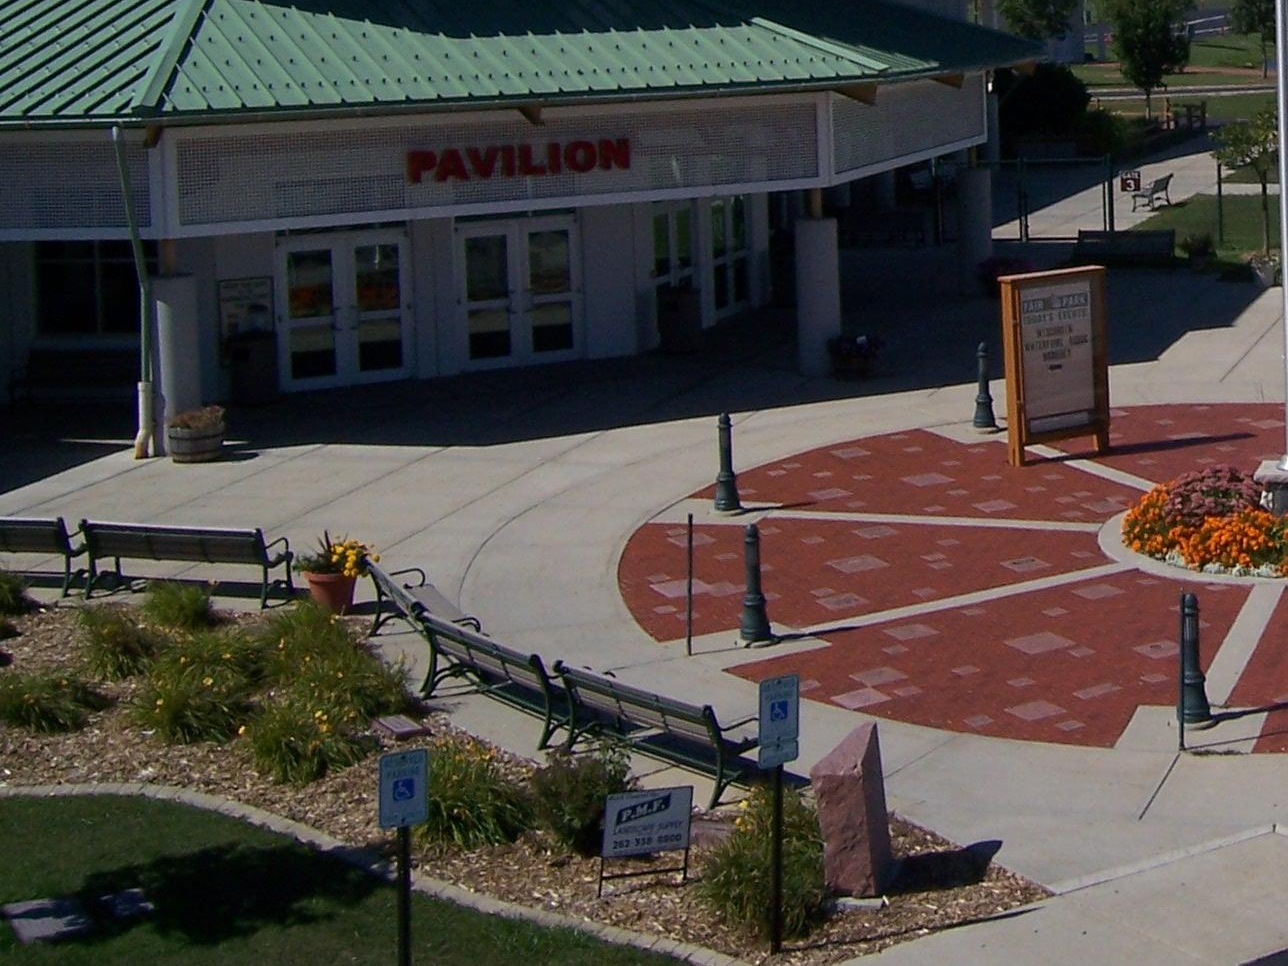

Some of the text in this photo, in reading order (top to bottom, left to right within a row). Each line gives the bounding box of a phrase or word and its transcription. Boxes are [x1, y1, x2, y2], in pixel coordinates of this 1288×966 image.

[407, 138, 631, 184] PAVILION
[1126, 179, 1135, 191] 3
[1062, 295, 1086, 307] PARK
